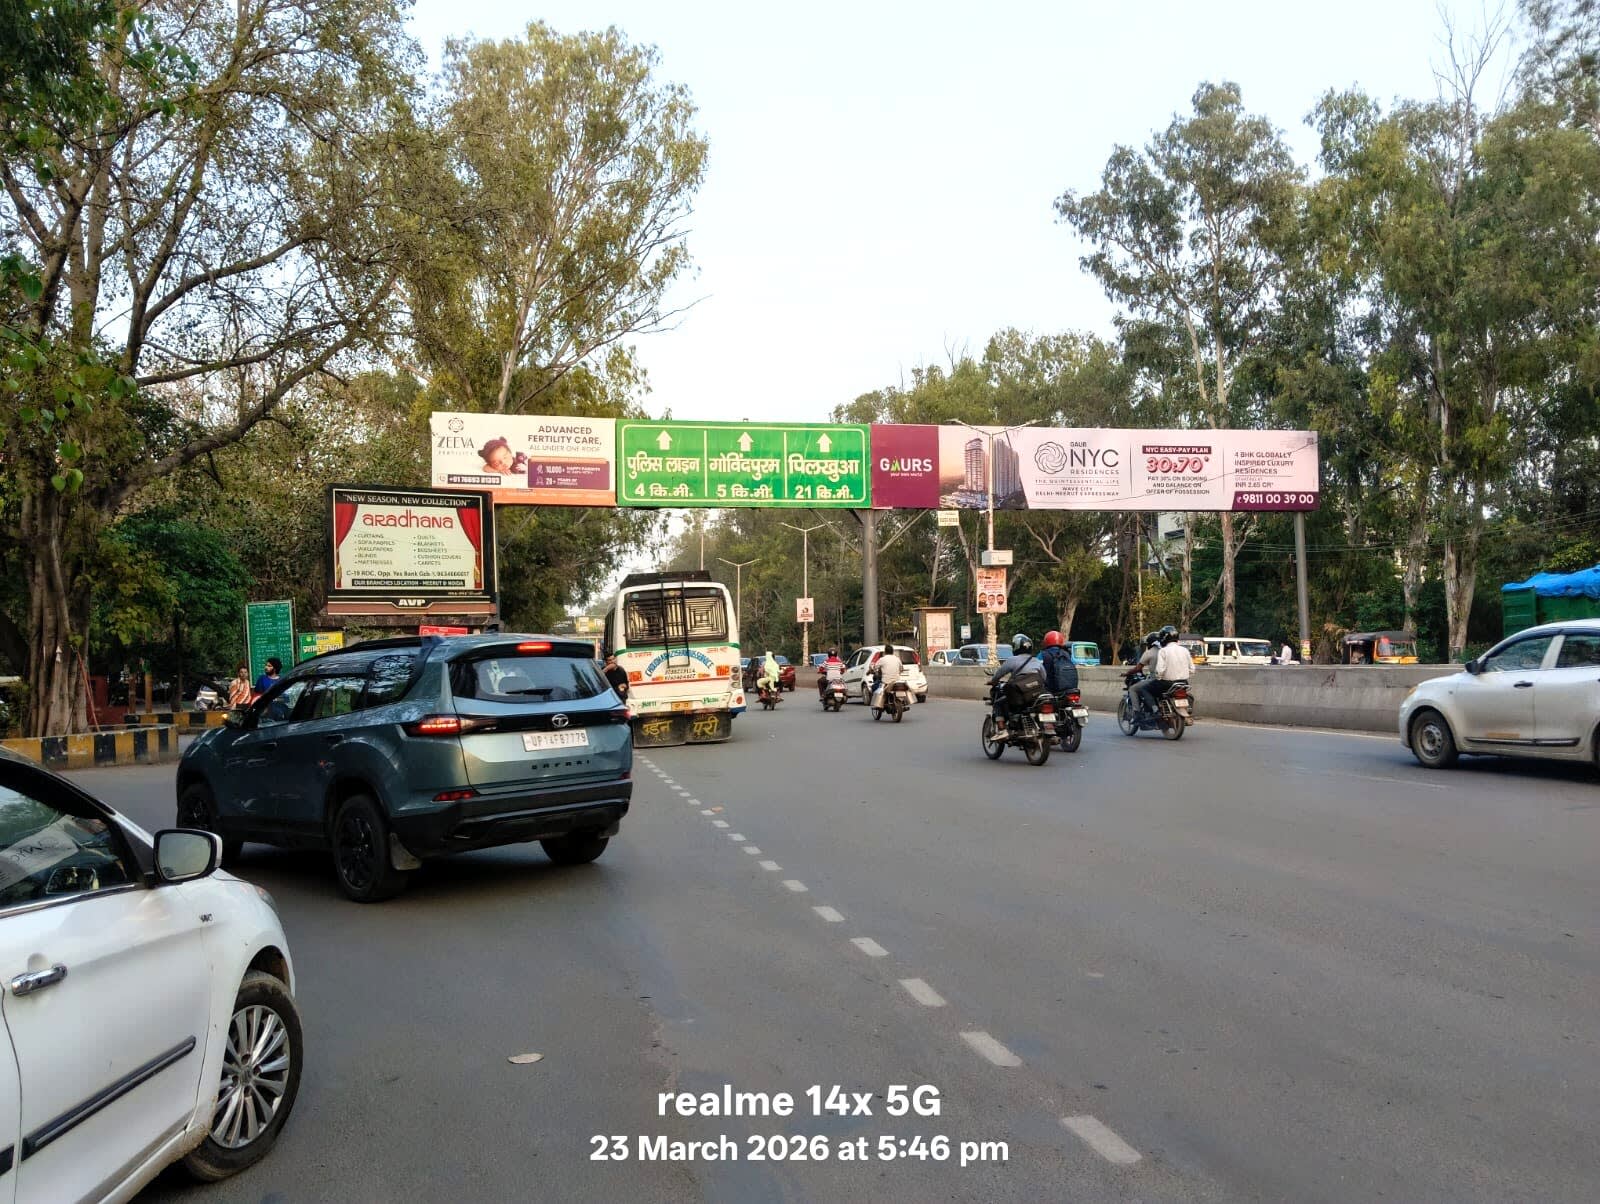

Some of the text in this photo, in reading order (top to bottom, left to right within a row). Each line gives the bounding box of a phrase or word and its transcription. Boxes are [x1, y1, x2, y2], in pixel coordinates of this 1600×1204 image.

[538, 425, 592, 434] ADVANCED
[437, 437, 474, 448] ZEEVA
[528, 435, 602, 445] FERTILITY CARE,
[627, 451, 700, 478] पुलिस लाइन
[880, 457, 932, 472] GAURS
[1070, 448, 1119, 468] NYC
[708, 452, 780, 480] गोविंदपुरम
[788, 453, 860, 481] पिलखुआ
[635, 483, 693, 498] 4 कि.मी.
[717, 484, 774, 498] 5 कि.मी.
[795, 485, 854, 499] 21 कि.मी.
[367, 495, 400, 504] SEASON,
[402, 496, 420, 504] NEW
[1242, 494, 1314, 504] 9811 00 39 00
